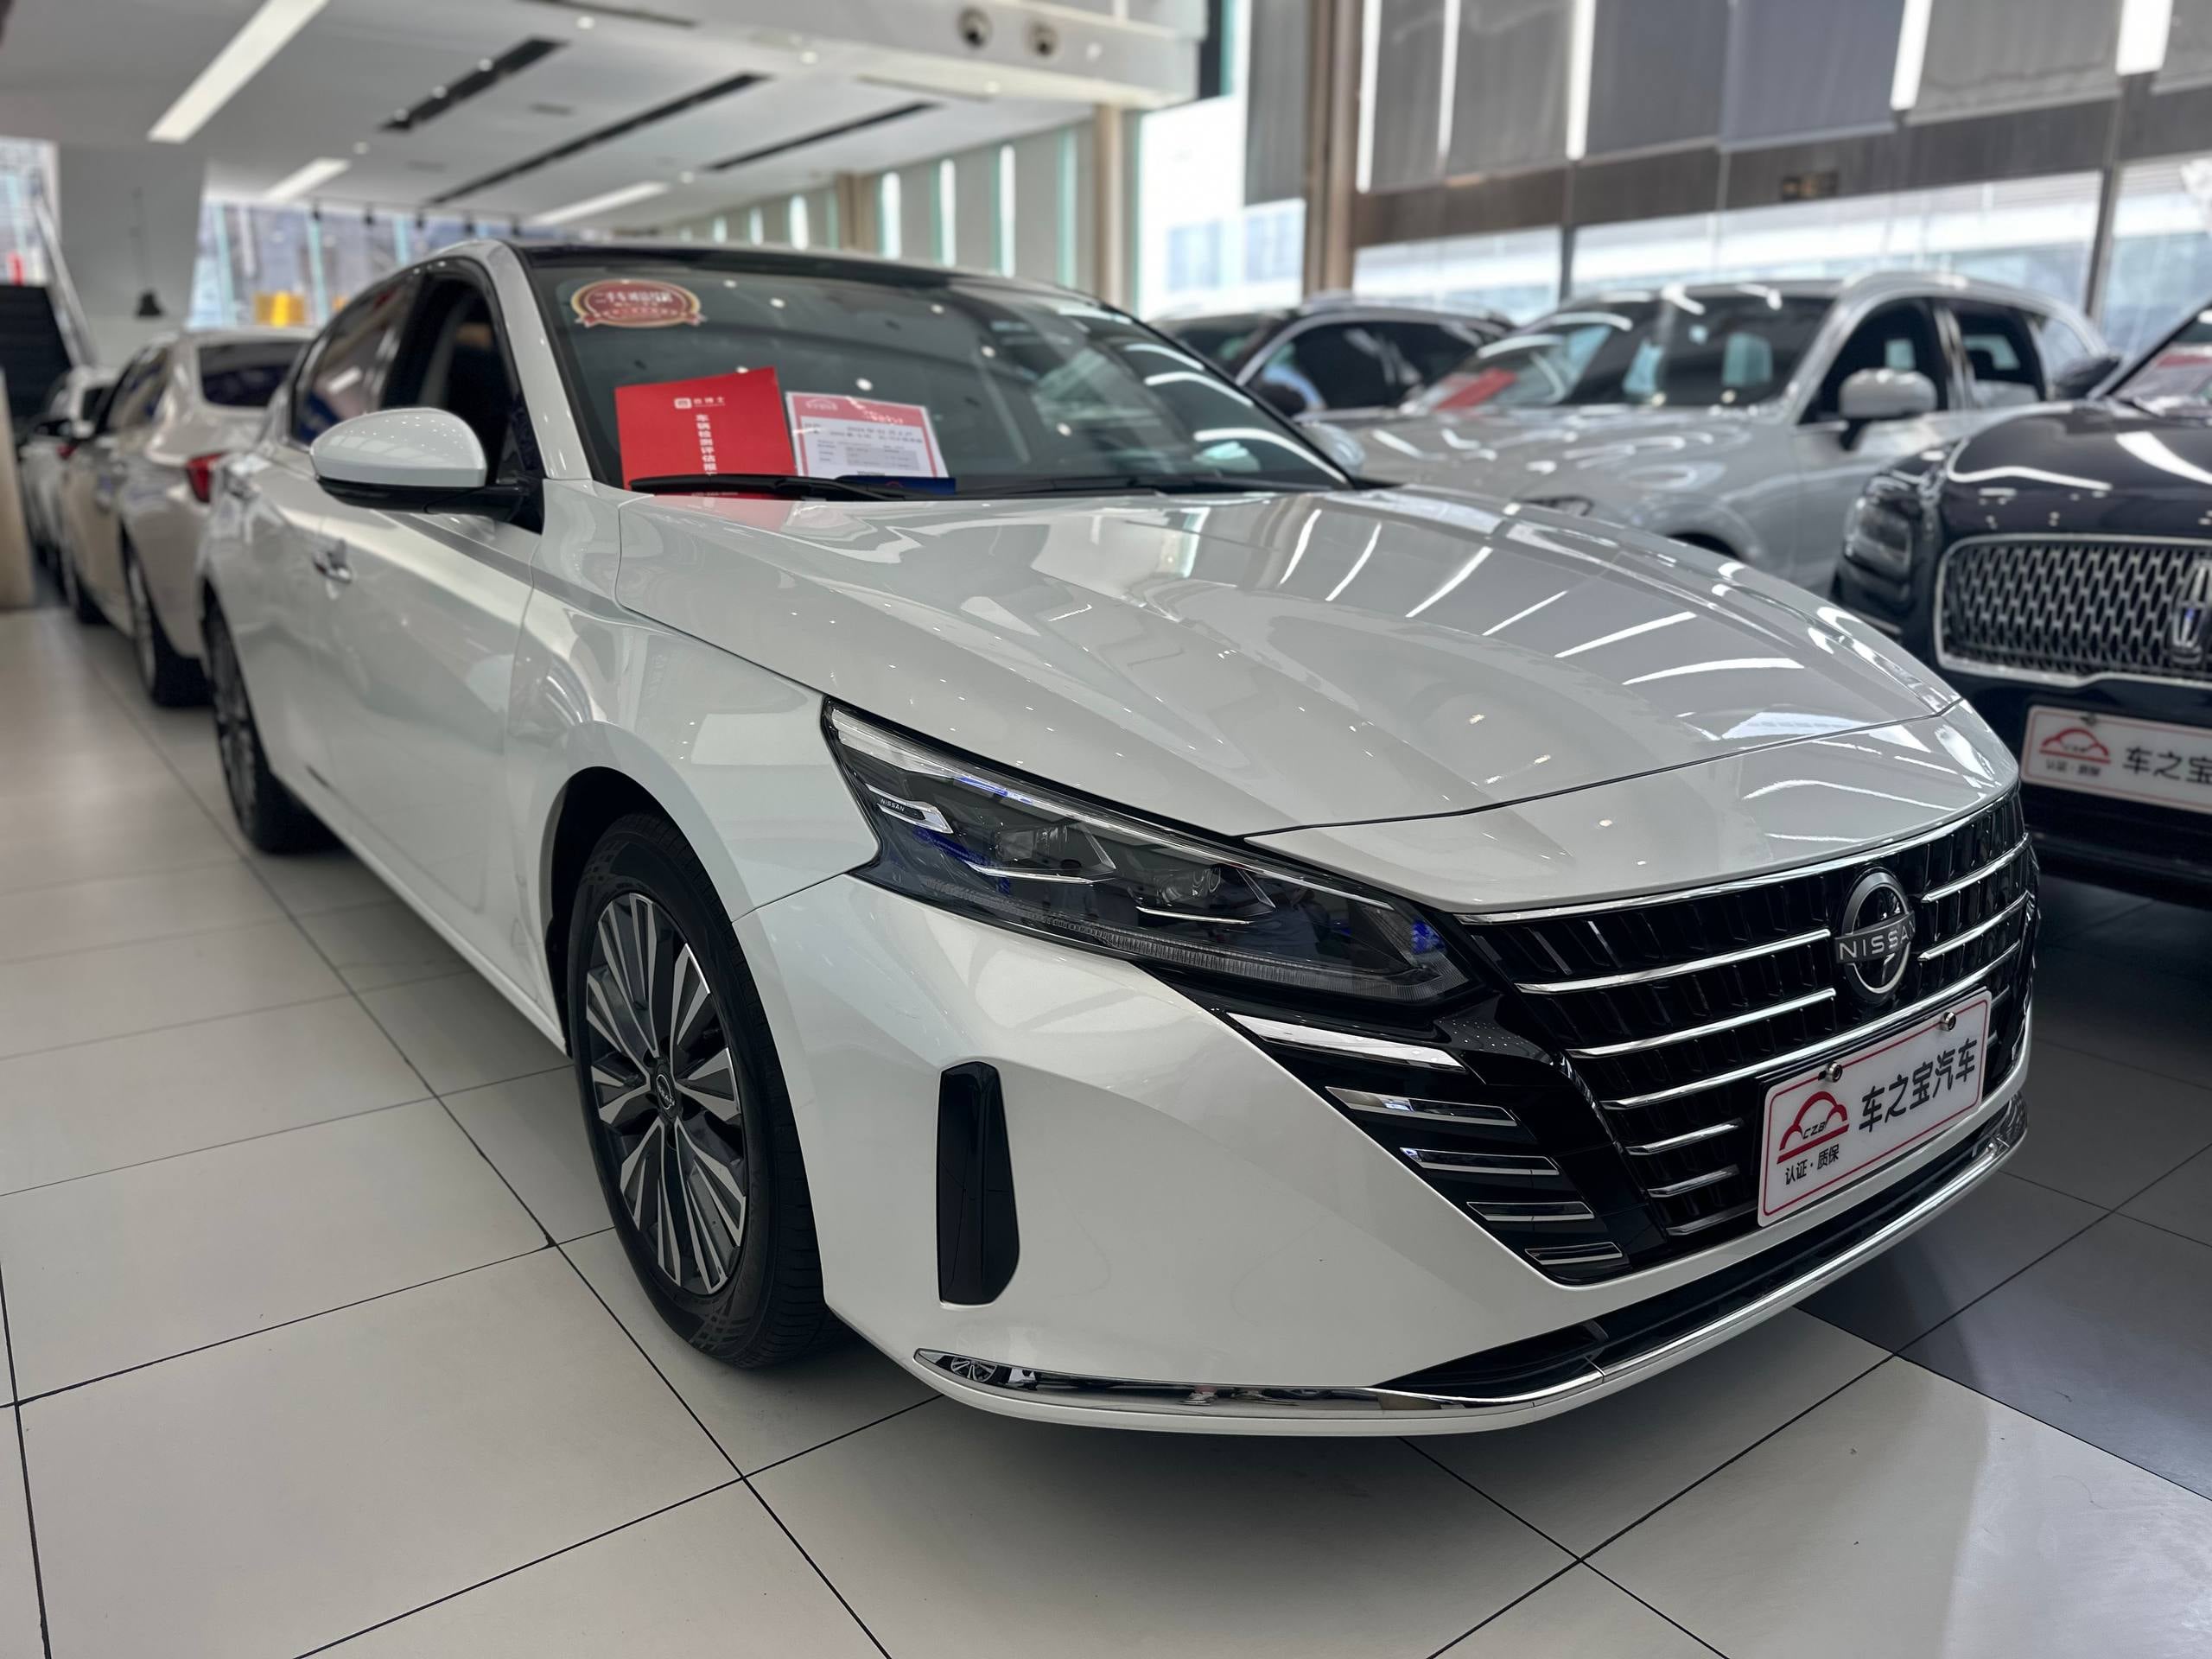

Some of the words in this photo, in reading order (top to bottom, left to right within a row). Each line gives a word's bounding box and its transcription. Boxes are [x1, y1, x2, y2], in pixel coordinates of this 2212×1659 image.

[696, 414, 717, 475] 车辆检测评估报
[2123, 746, 2212, 785] 车之宝
[880, 798, 905, 812] NISSAN
[1839, 919, 1916, 961] NISSAN
[1859, 1039, 1978, 1133] 车之宝汽车
[1802, 1121, 1827, 1141] CZB
